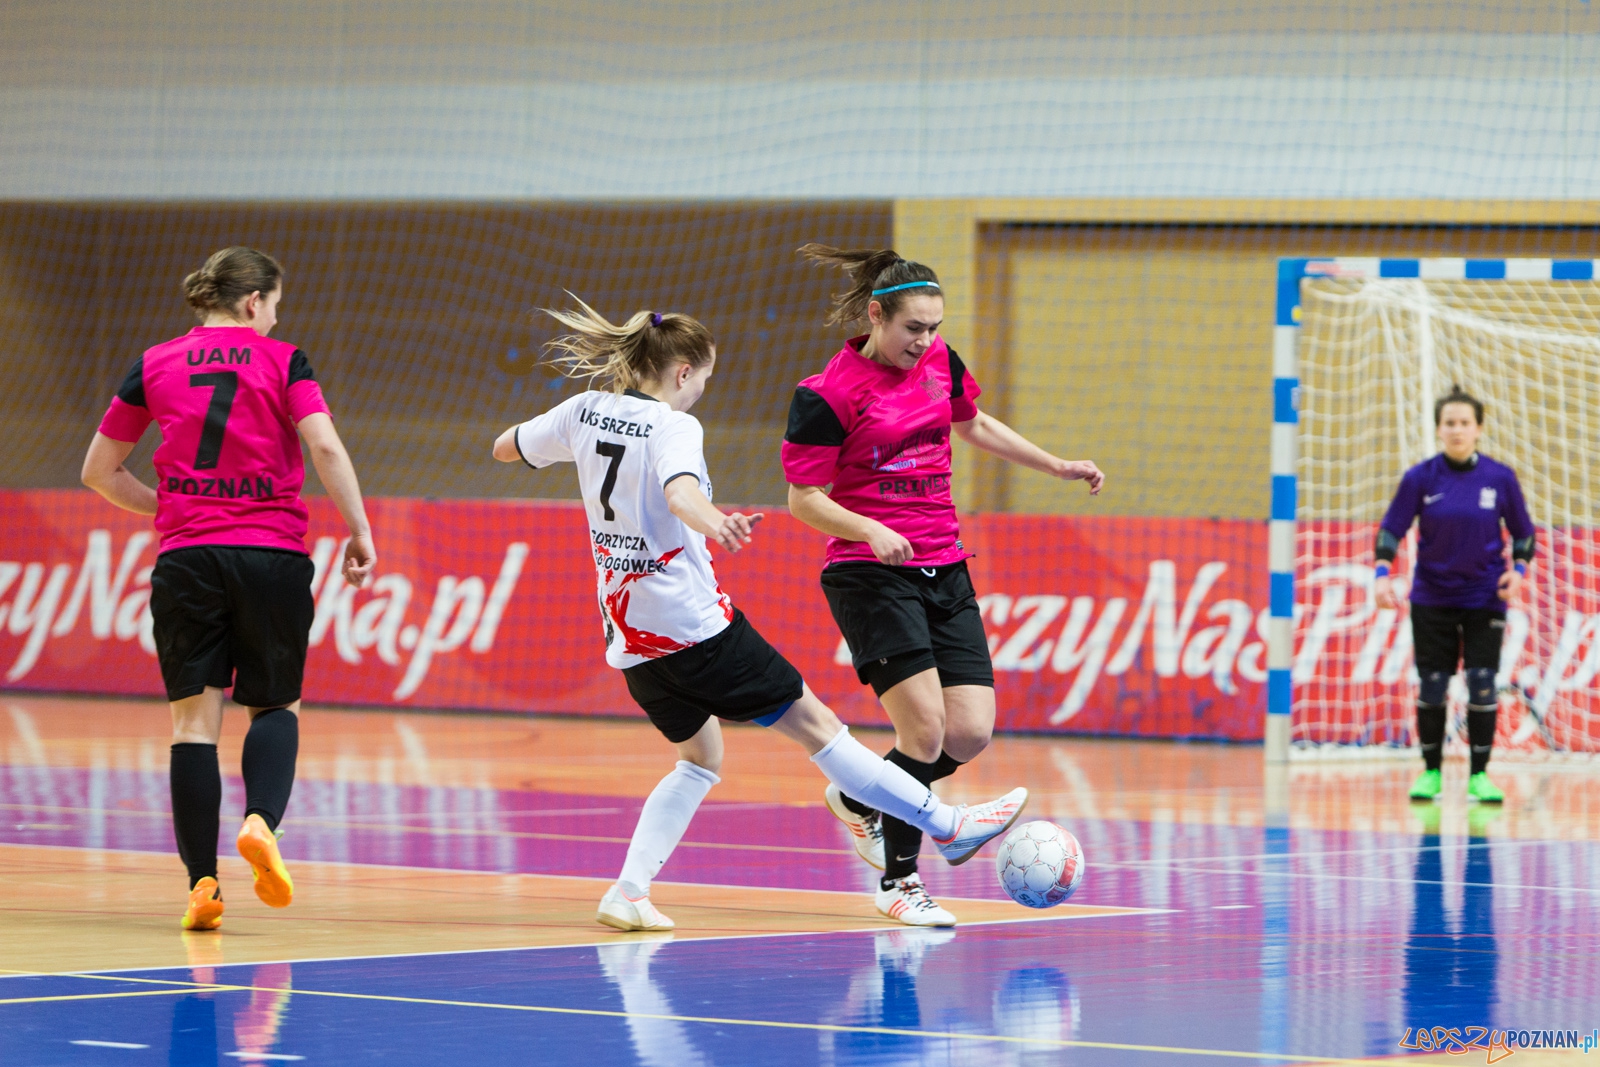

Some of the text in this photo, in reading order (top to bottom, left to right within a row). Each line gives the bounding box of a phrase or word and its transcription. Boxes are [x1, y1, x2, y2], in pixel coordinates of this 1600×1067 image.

[187, 347, 252, 367] UAM
[189, 371, 238, 470] 7
[596, 439, 626, 522] 7
